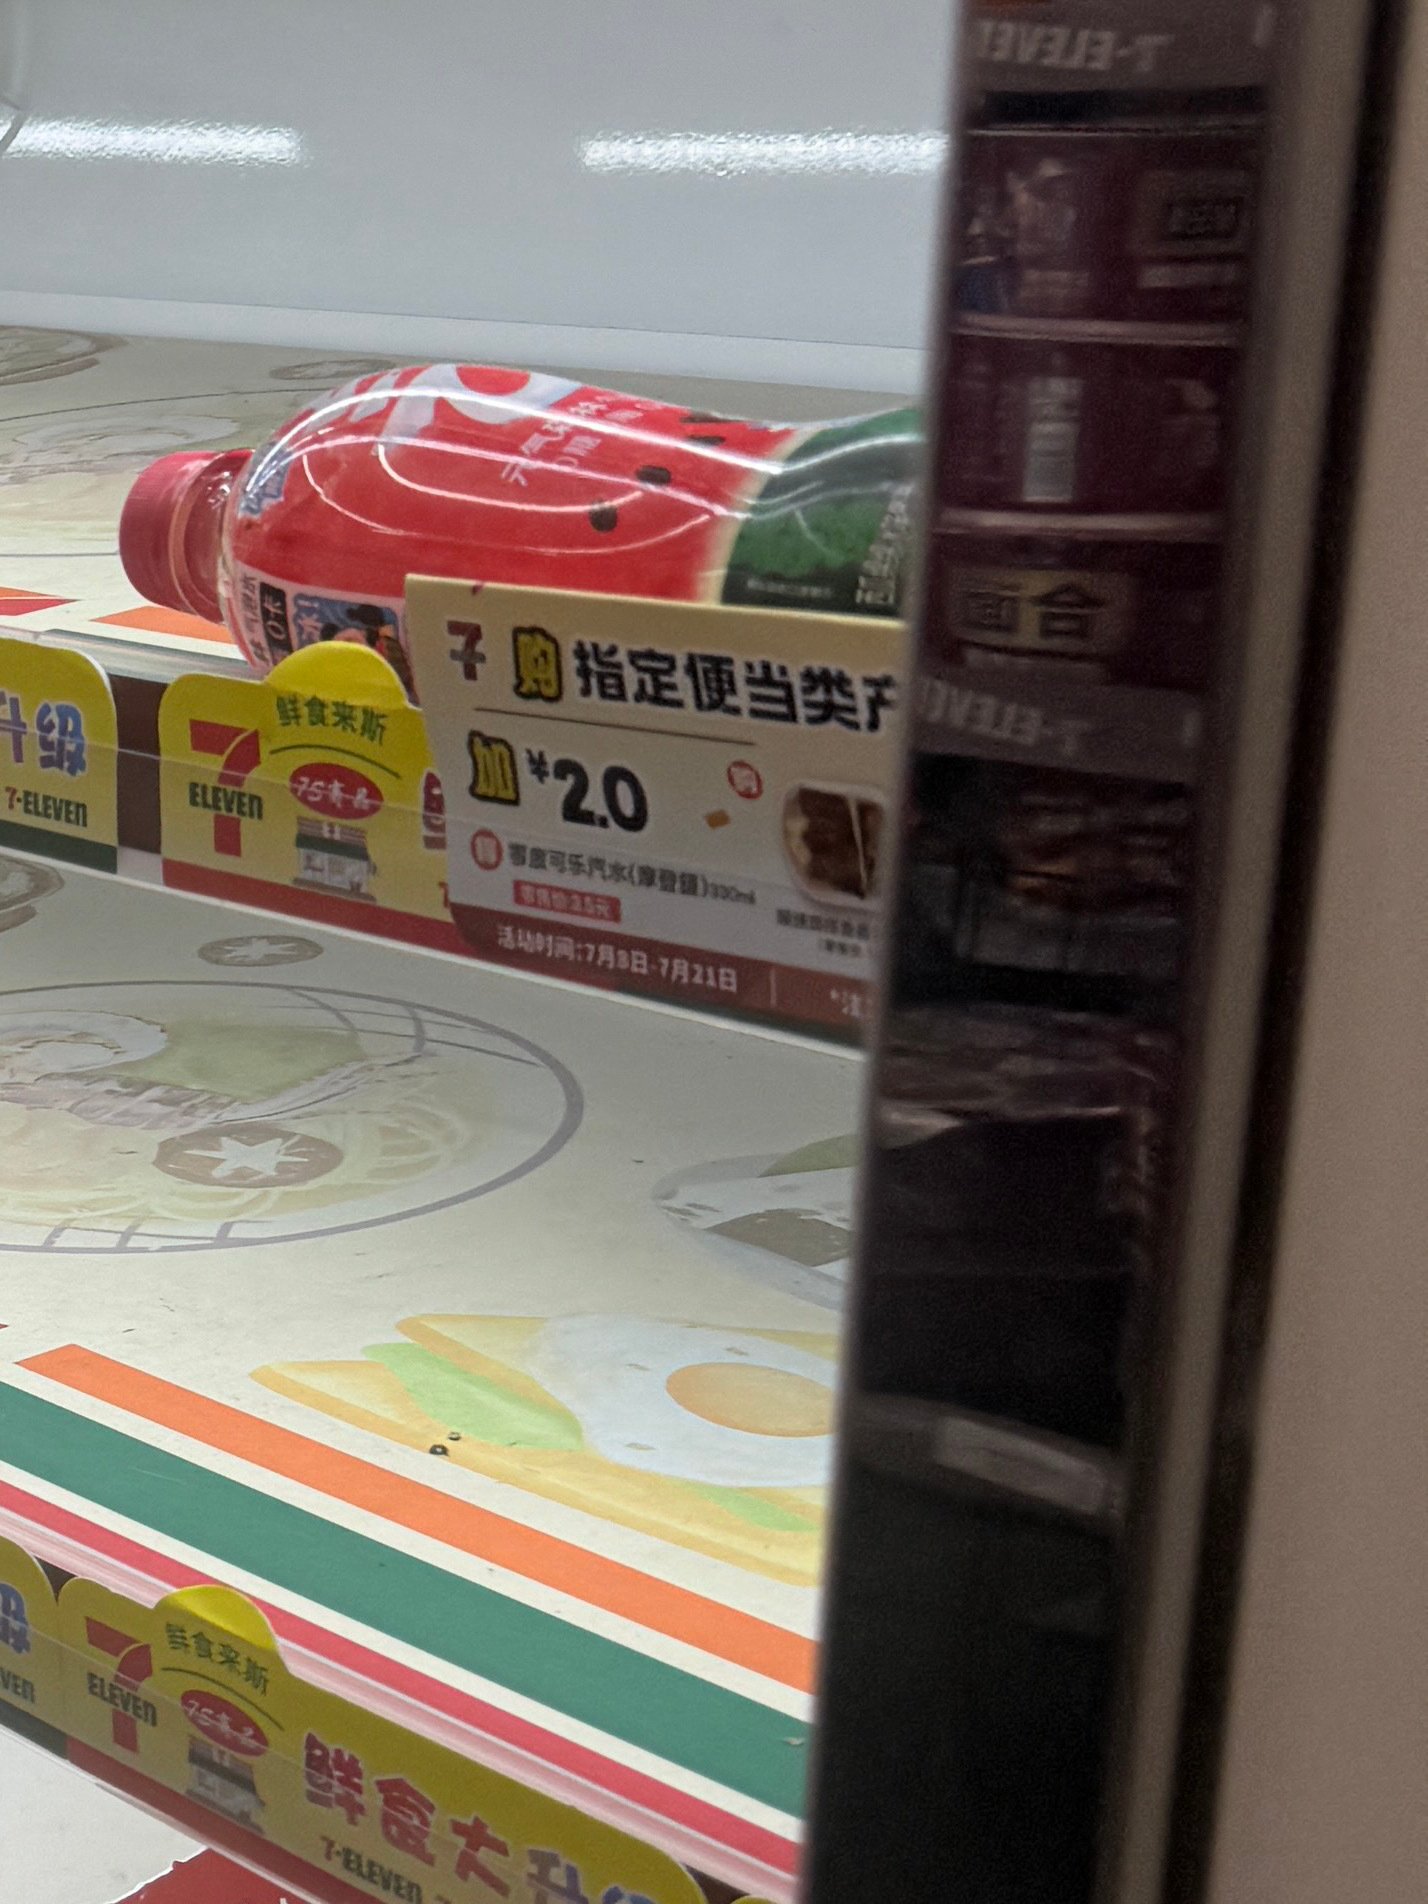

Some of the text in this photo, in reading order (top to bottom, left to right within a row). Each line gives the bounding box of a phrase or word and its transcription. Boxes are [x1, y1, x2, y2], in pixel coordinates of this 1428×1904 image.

[277, 698, 386, 741] 鲜食来斯
[189, 719, 260, 857] 7
[469, 730, 519, 806] 加
[526, 748, 648, 832] ¥2.0
[87, 1617, 153, 1754] 7
[165, 1620, 269, 1697] 鲜食来斯
